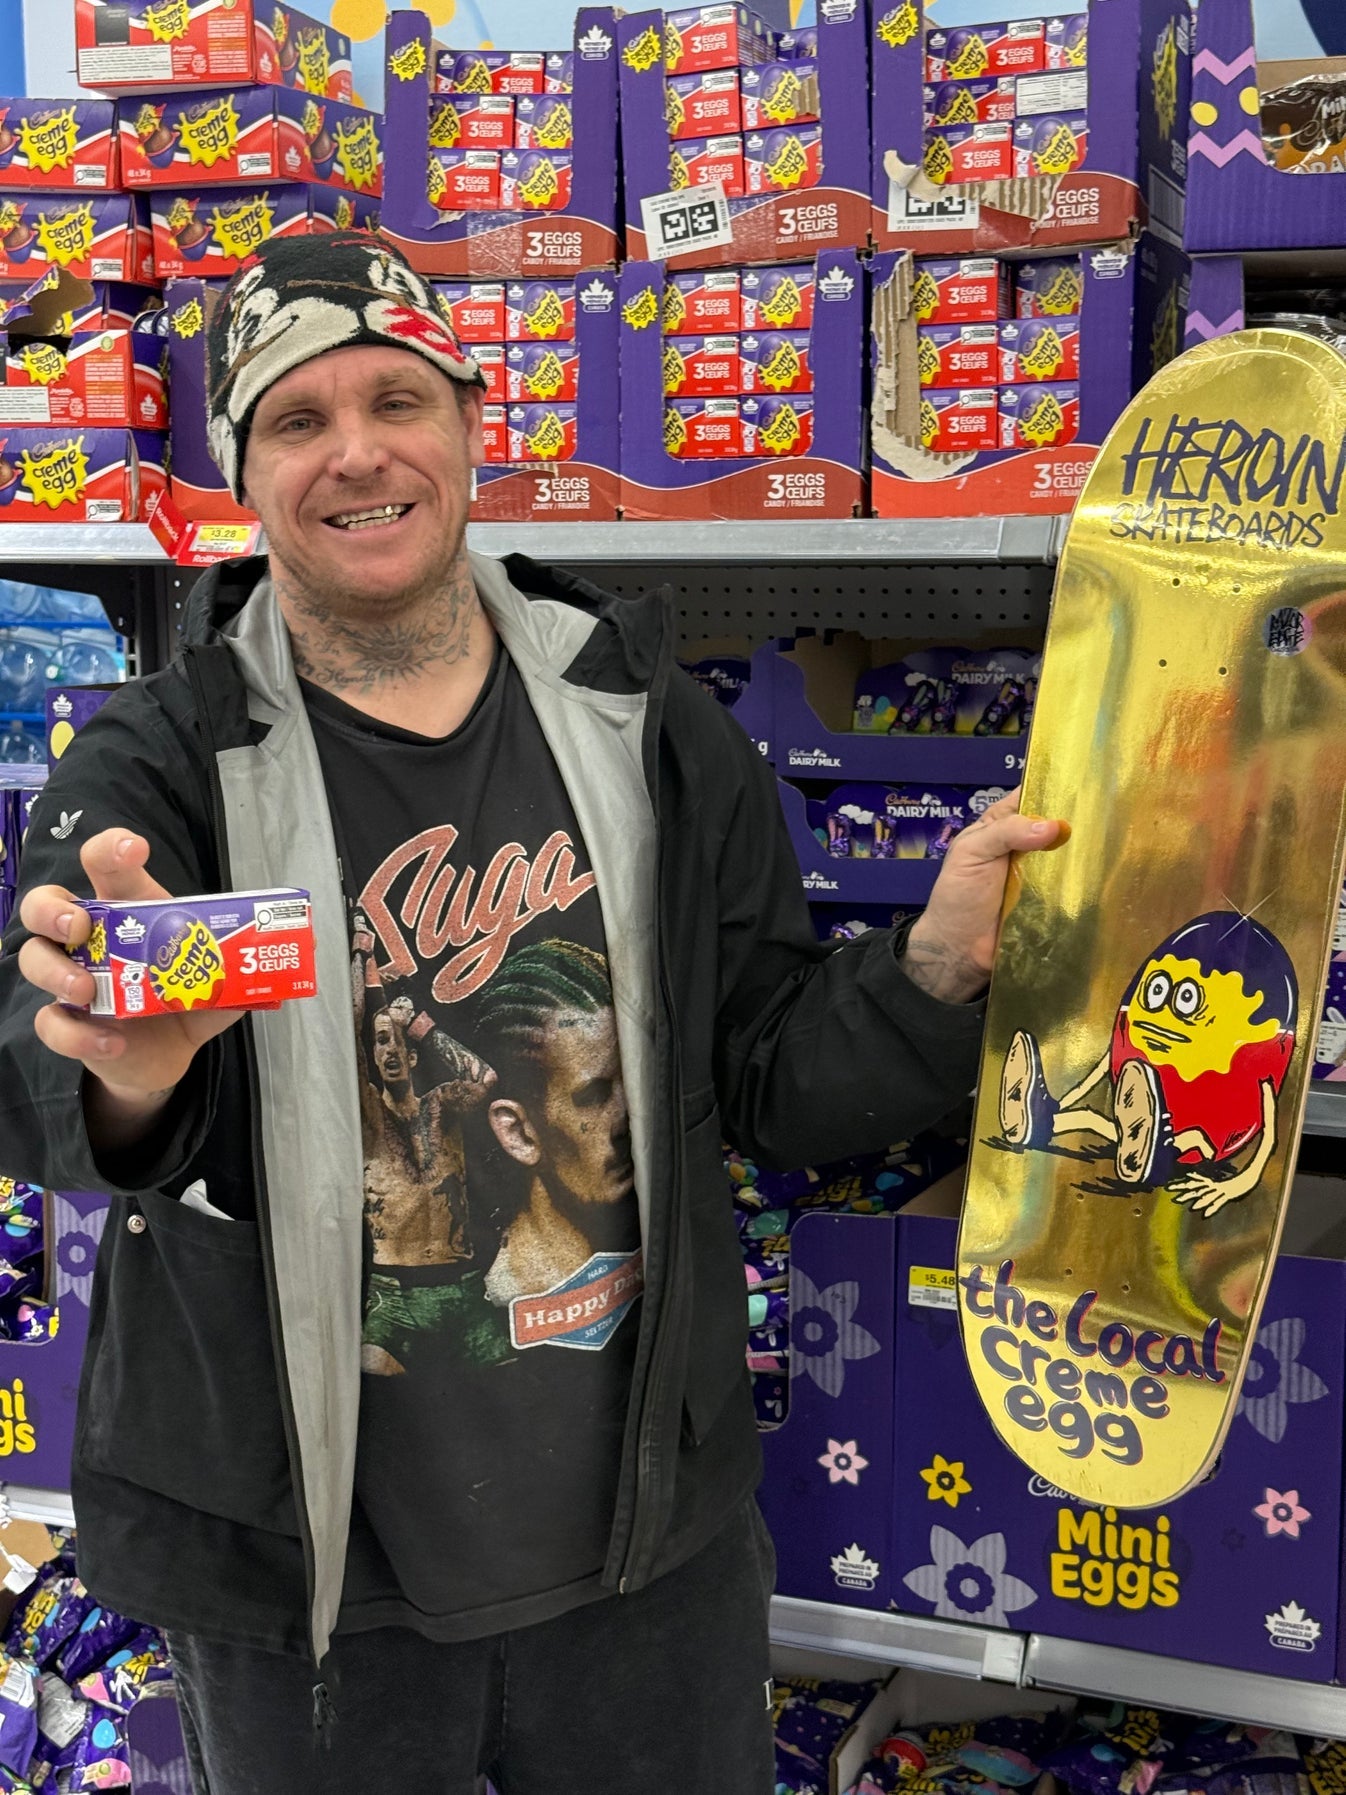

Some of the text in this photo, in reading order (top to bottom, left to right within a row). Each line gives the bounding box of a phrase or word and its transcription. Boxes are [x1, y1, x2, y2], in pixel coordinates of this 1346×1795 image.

[159, 15, 183, 34] egg
[691, 33, 726, 53] 3 EGGS
[996, 47, 1033, 65] 3 EGGS
[499, 78, 509, 93] 3
[693, 99, 729, 119] 3 EGGS
[986, 105, 996, 120] 3
[29, 118, 71, 144] creme
[189, 107, 231, 139] creme
[468, 121, 478, 137] 3
[37, 135, 68, 159] egg
[198, 127, 229, 152] egg
[351, 150, 372, 175] egg
[782, 154, 805, 179] egg
[962, 150, 1000, 169] 3 EGGS
[454, 176, 489, 192] 3 EGGS
[697, 164, 733, 183] 3 EGGS
[1056, 188, 1099, 204] EGGS
[222, 204, 265, 233] creme
[778, 204, 837, 234] 3 EGGS
[1056, 202, 1099, 218] ŒUFS
[47, 212, 88, 239] creme
[231, 223, 264, 248] egg
[797, 218, 838, 233] ŒUFS
[54, 231, 84, 253] egg
[526, 232, 582, 256] 3 EGGS
[544, 245, 582, 257] ŒUFS
[948, 286, 987, 304] 3 EGGS
[694, 299, 729, 317] 3 EGGS
[776, 296, 798, 317] egg
[460, 310, 495, 326] 3 EGGS
[541, 308, 561, 329] egg
[36, 356, 60, 375] egg
[949, 352, 988, 370] 3 EGGS
[1037, 346, 1061, 369] egg
[541, 370, 561, 391] egg
[693, 362, 730, 379] 3 EGGS
[776, 359, 798, 381] egg
[694, 425, 730, 441] 3 EGGS
[776, 421, 797, 443] egg
[948, 416, 986, 433] 3 EGGS
[1037, 410, 1061, 435] egg
[542, 429, 562, 451] egg
[33, 448, 79, 478] creme
[1120, 413, 1346, 515] HEROIN
[42, 466, 76, 494] egg
[768, 474, 825, 499] 3 EGGS
[1033, 464, 1052, 489] 3
[1052, 476, 1085, 488] ŒUF
[535, 477, 589, 502] 3 EGGS
[552, 490, 590, 501] ŒUFS
[785, 486, 825, 499] ŒUFS
[1109, 500, 1326, 550] SKATEBOARDS
[951, 673, 990, 684] DAIRY
[758, 741, 768, 755] g
[789, 757, 841, 767] DAIRY MILK
[1005, 755, 1015, 769] 9
[887, 806, 964, 818] DAIRY MILK
[816, 880, 839, 889] MILK
[357, 823, 598, 1004] Suga
[167, 928, 209, 985] creme
[239, 943, 299, 975] 3 EGGS
[259, 957, 300, 972] ŒUFS
[184, 948, 220, 989] egg
[587, 1265, 608, 1280] HARD
[925, 1274, 955, 1286] $5.48
[524, 1288, 611, 1328] Happy
[958, 1258, 1058, 1341] the
[1003, 1384, 1144, 1467] egg
[1057, 1506, 1171, 1569] Mini
[1050, 1552, 1180, 1610] Eggs
